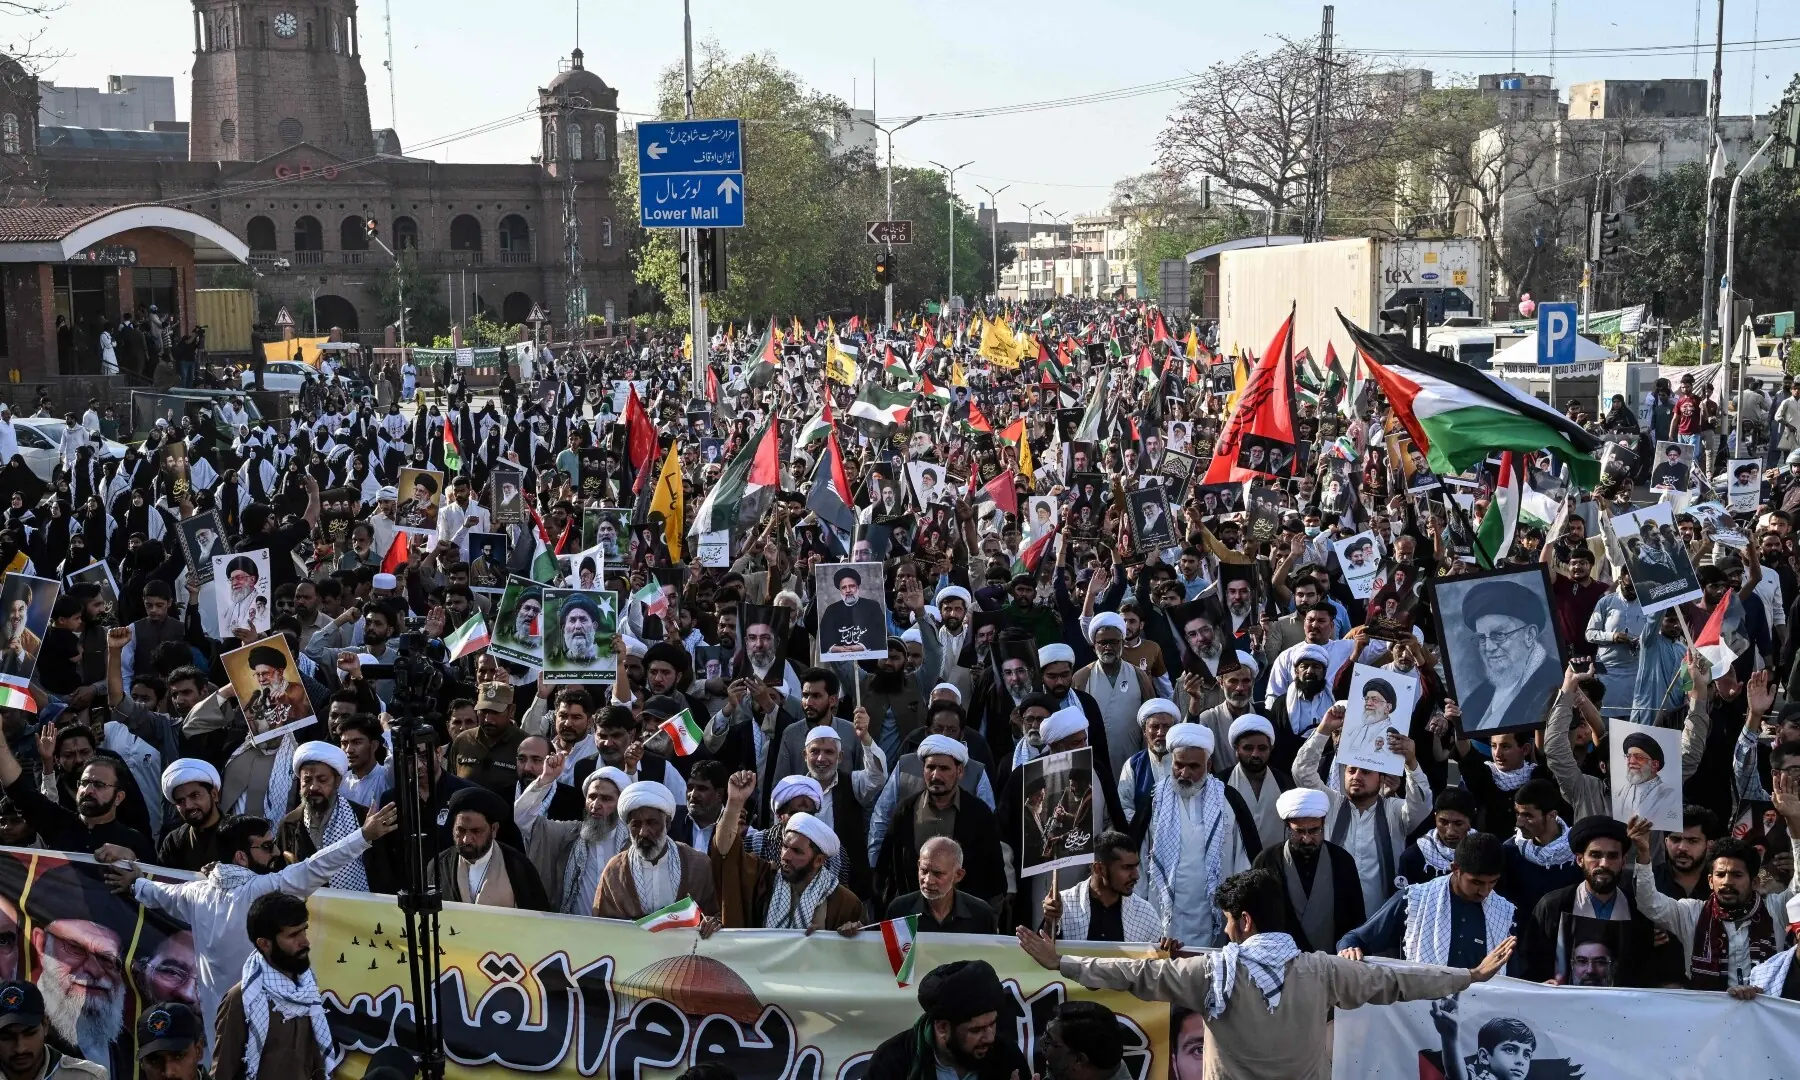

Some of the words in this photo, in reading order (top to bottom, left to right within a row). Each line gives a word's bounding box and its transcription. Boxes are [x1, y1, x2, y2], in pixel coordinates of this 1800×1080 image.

[699, 129, 723, 143] حضرت
[721, 129, 735, 143] مزار
[693, 151, 717, 163] اوقاف
[656, 177, 678, 204] مال
[644, 207, 687, 220] Lower
[691, 206, 719, 220] Mall
[1385, 265, 1414, 284] tex
[1547, 311, 1568, 358] P
[1520, 365, 1537, 373] SAFETY
[1556, 366, 1569, 375] ROAD
[1570, 364, 1587, 373] SAFETY
[1588, 361, 1603, 371] CAMP
[1639, 410, 1649, 420] 37
